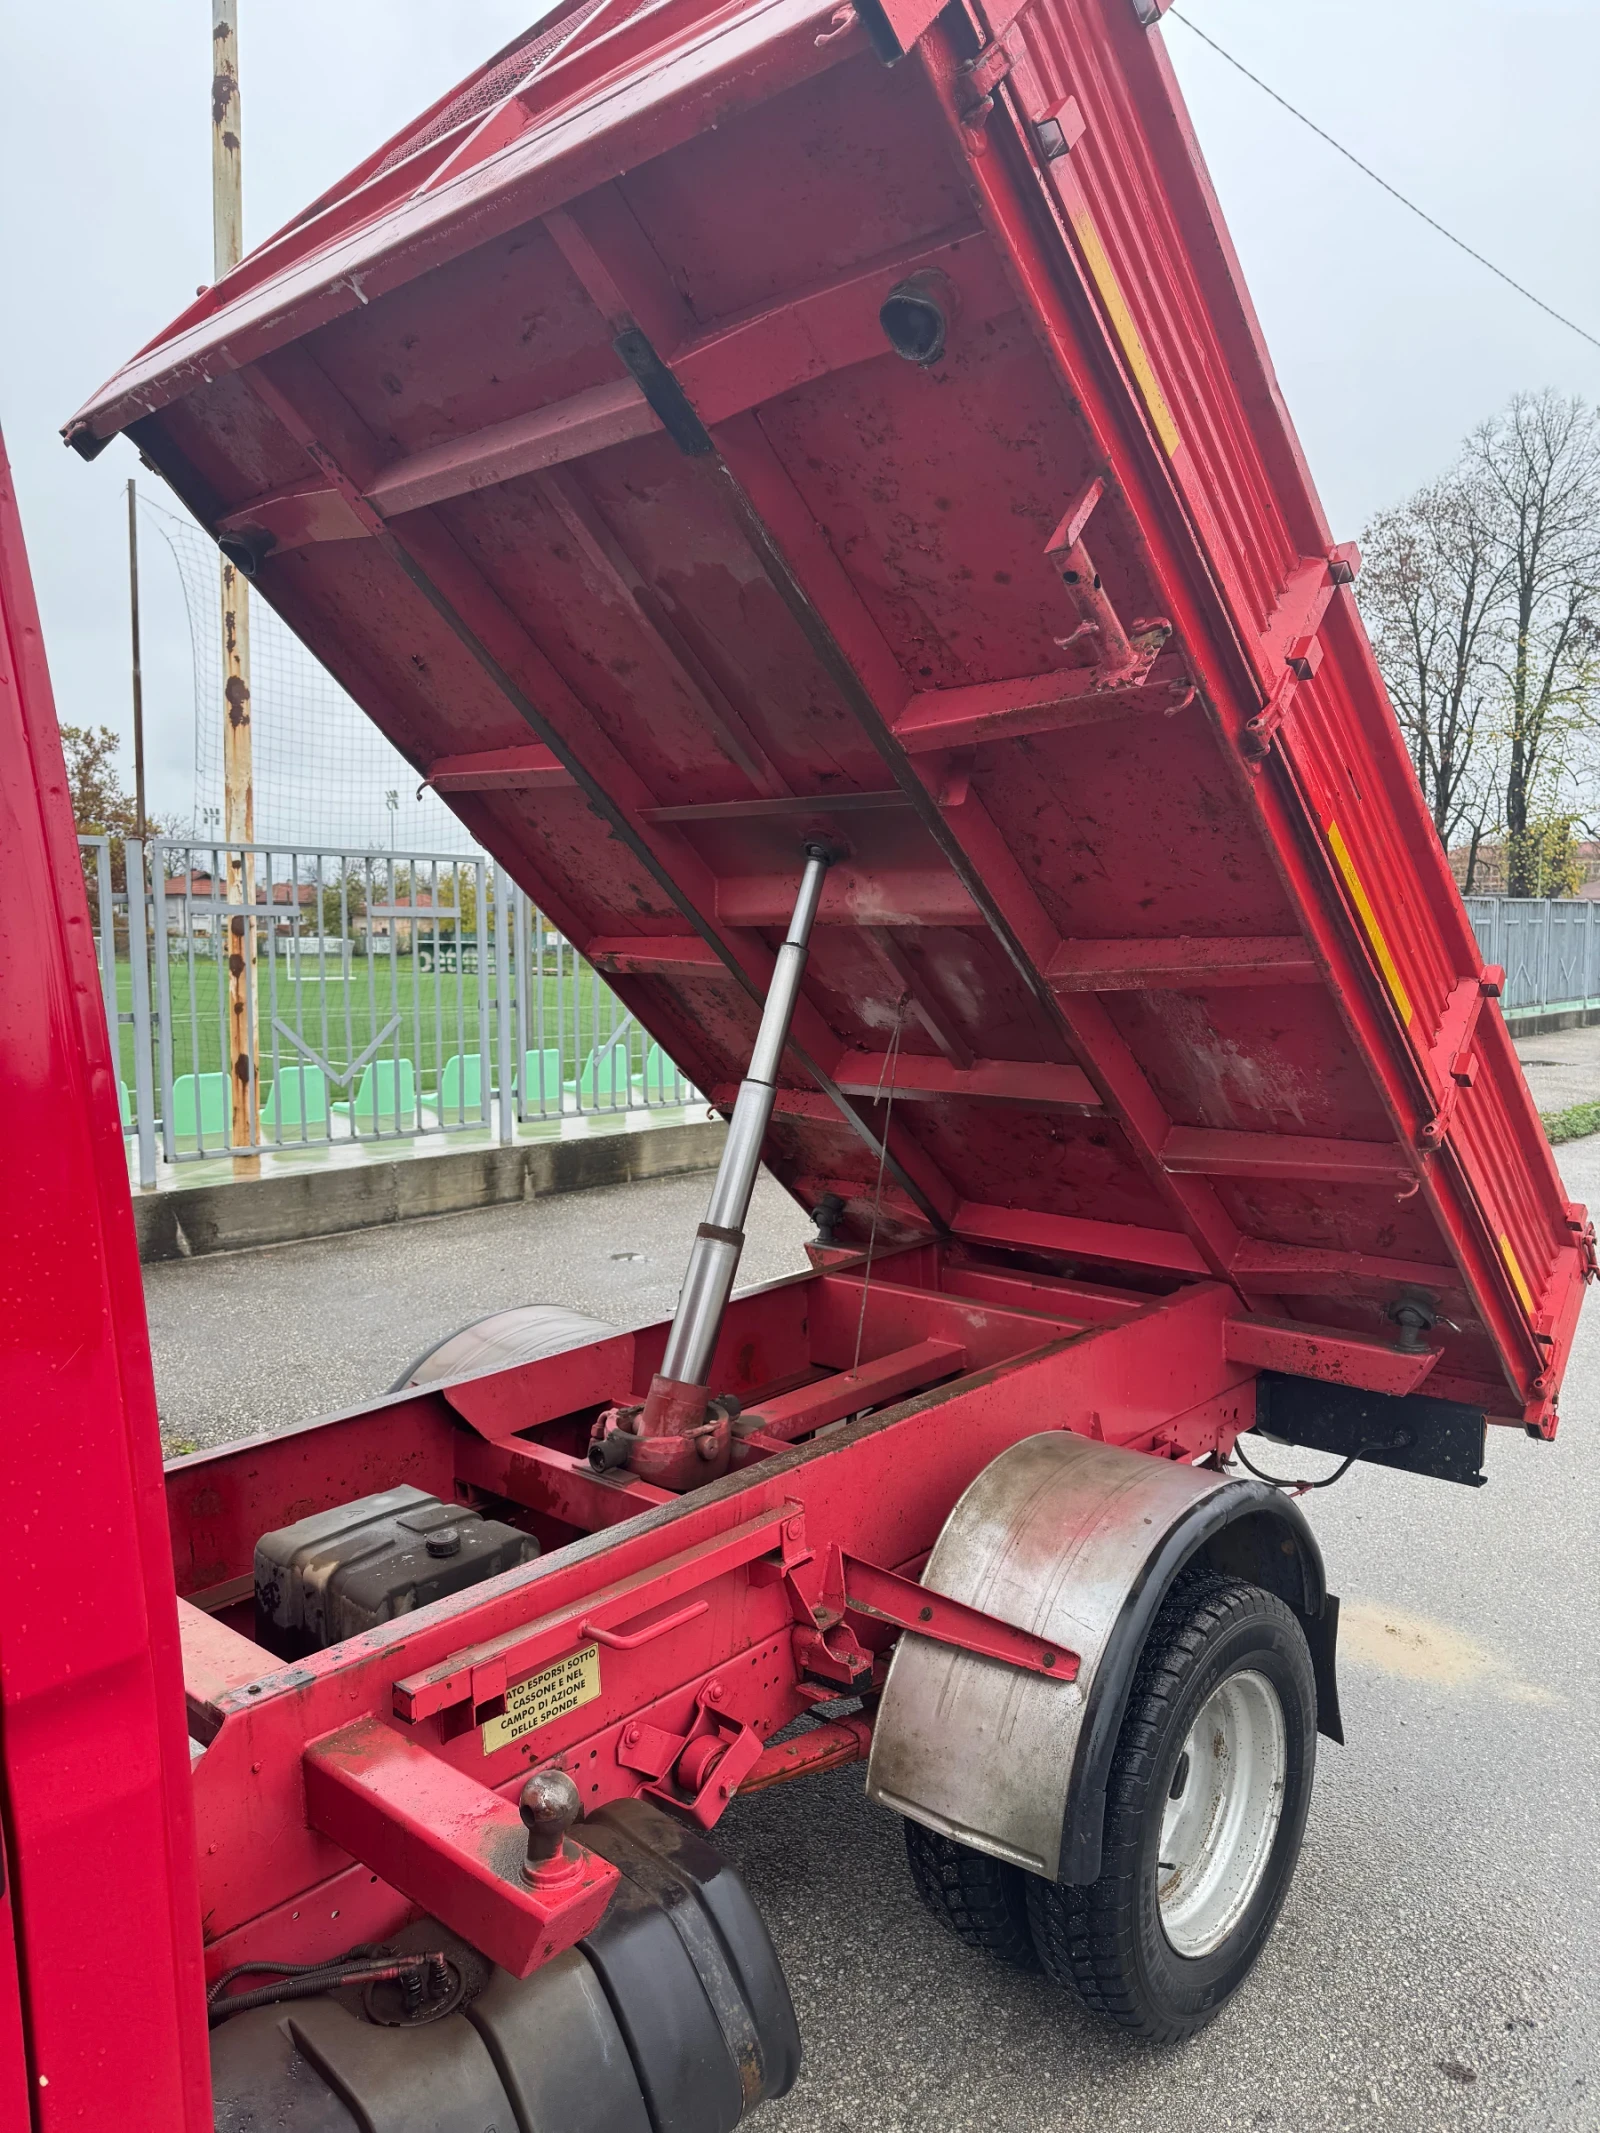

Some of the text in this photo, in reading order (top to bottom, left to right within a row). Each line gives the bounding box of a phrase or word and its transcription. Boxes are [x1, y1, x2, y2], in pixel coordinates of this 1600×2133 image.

[506, 1648, 596, 1701] ATO ESPORSI SOTTO
[513, 1668, 584, 1710] CASSONE E NEL
[500, 1679, 586, 1730] CAMPO DI AZIONE
[511, 1696, 578, 1738] DELLE SPONDE
